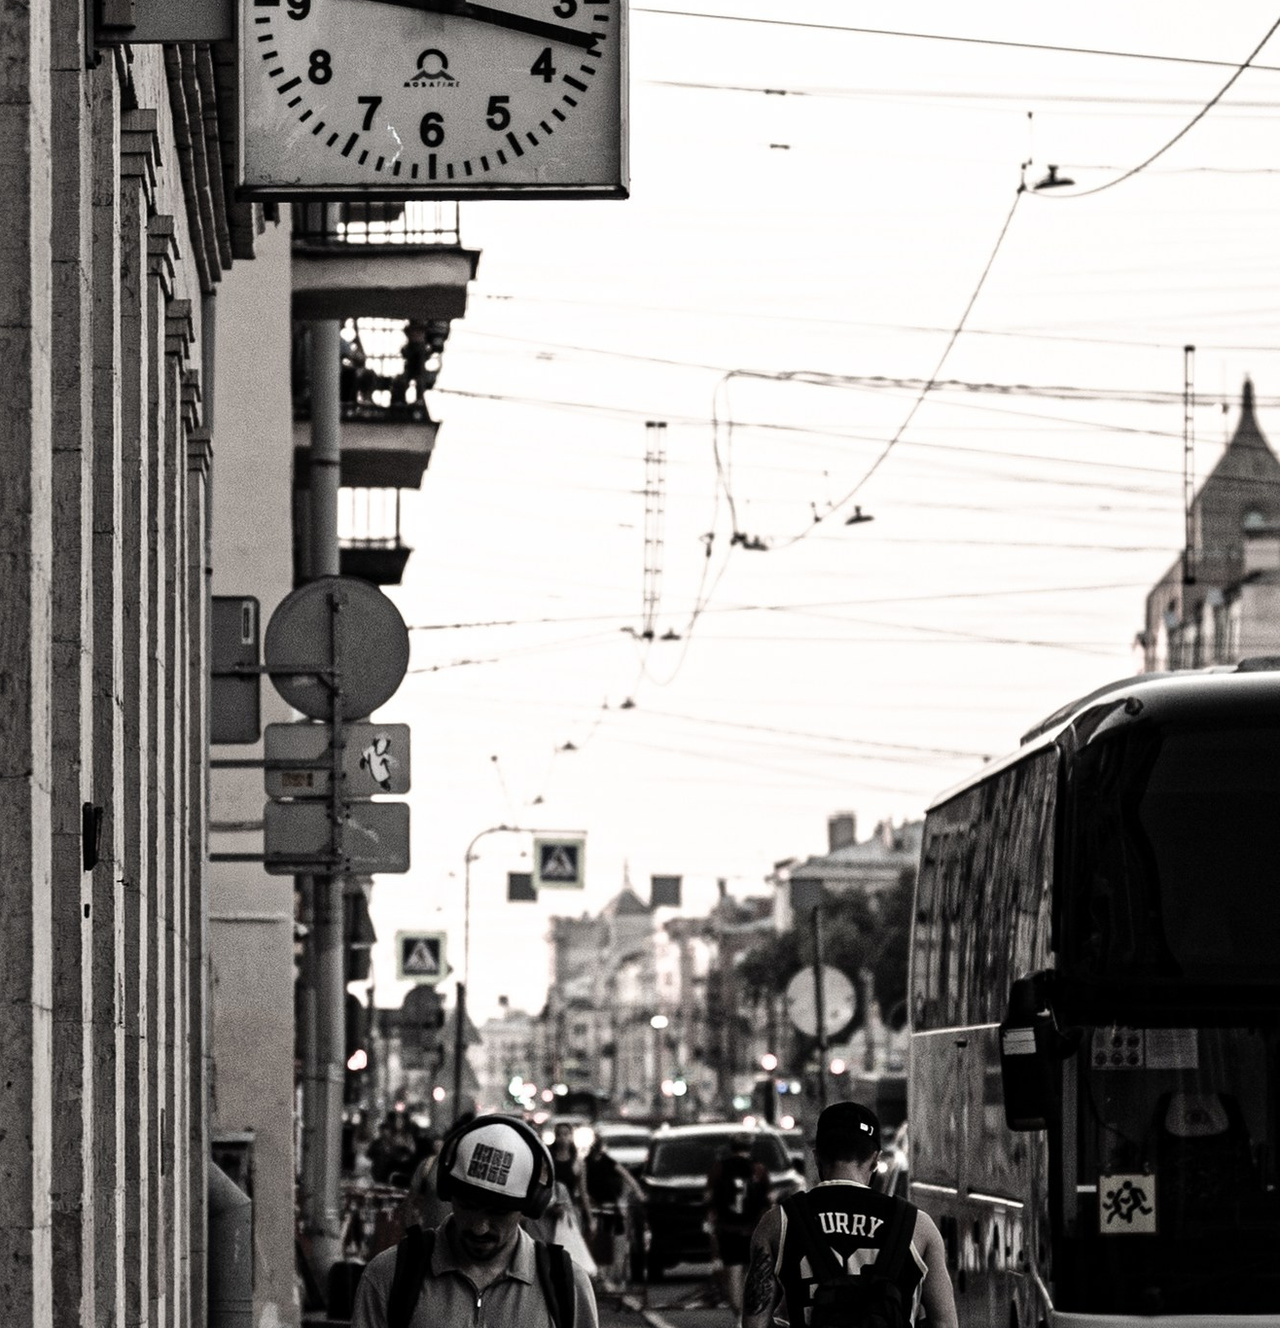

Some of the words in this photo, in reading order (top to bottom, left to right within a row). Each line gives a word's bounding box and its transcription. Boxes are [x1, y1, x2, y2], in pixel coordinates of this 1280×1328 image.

[307, 48, 333, 86] 8
[530, 46, 557, 84] 4
[357, 95, 383, 132] 7
[419, 111, 445, 149] 6
[485, 95, 511, 132] 5
[816, 1211, 885, 1239] URRY
